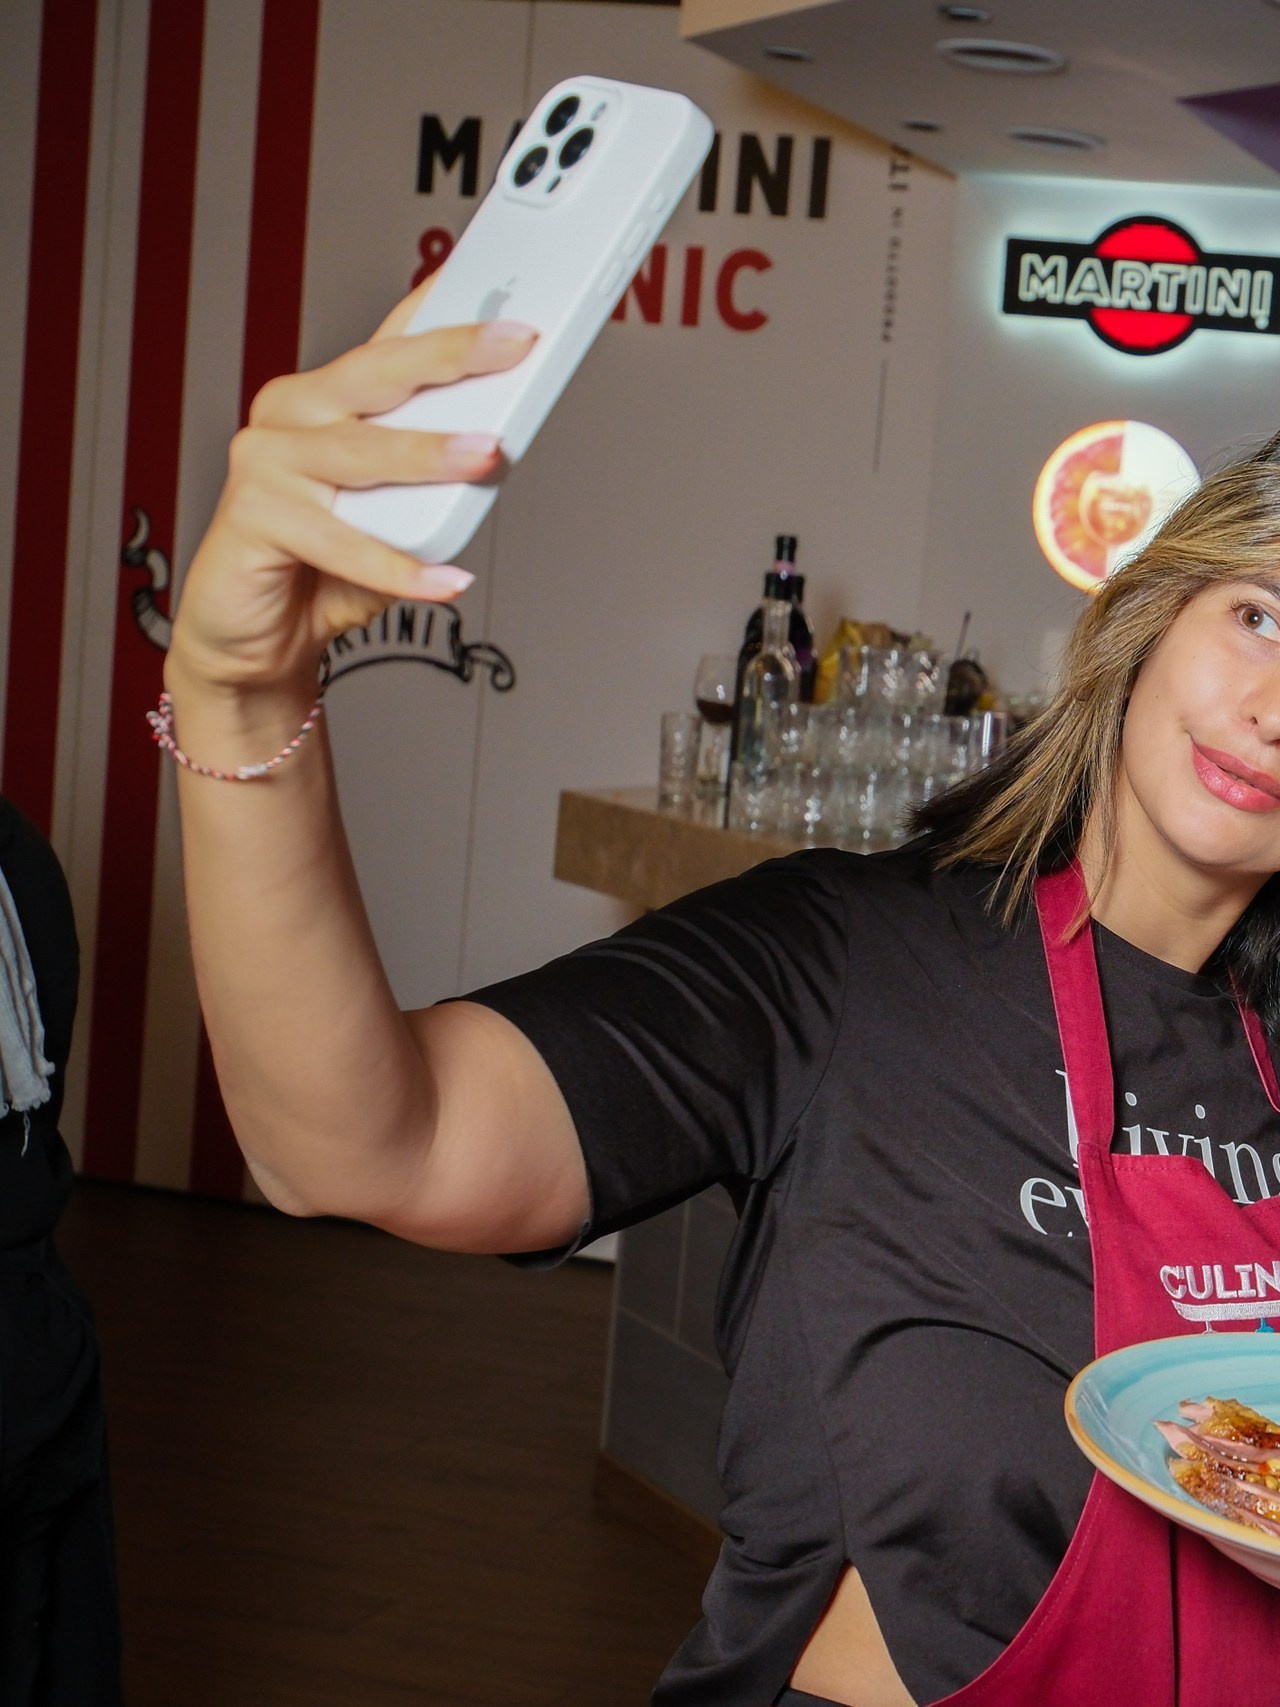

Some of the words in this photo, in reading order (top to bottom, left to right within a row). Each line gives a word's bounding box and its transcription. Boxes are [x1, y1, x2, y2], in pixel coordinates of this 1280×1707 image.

[416, 114, 832, 219] MINI
[610, 243, 774, 333] NIC
[1018, 252, 1274, 324] MARTINI
